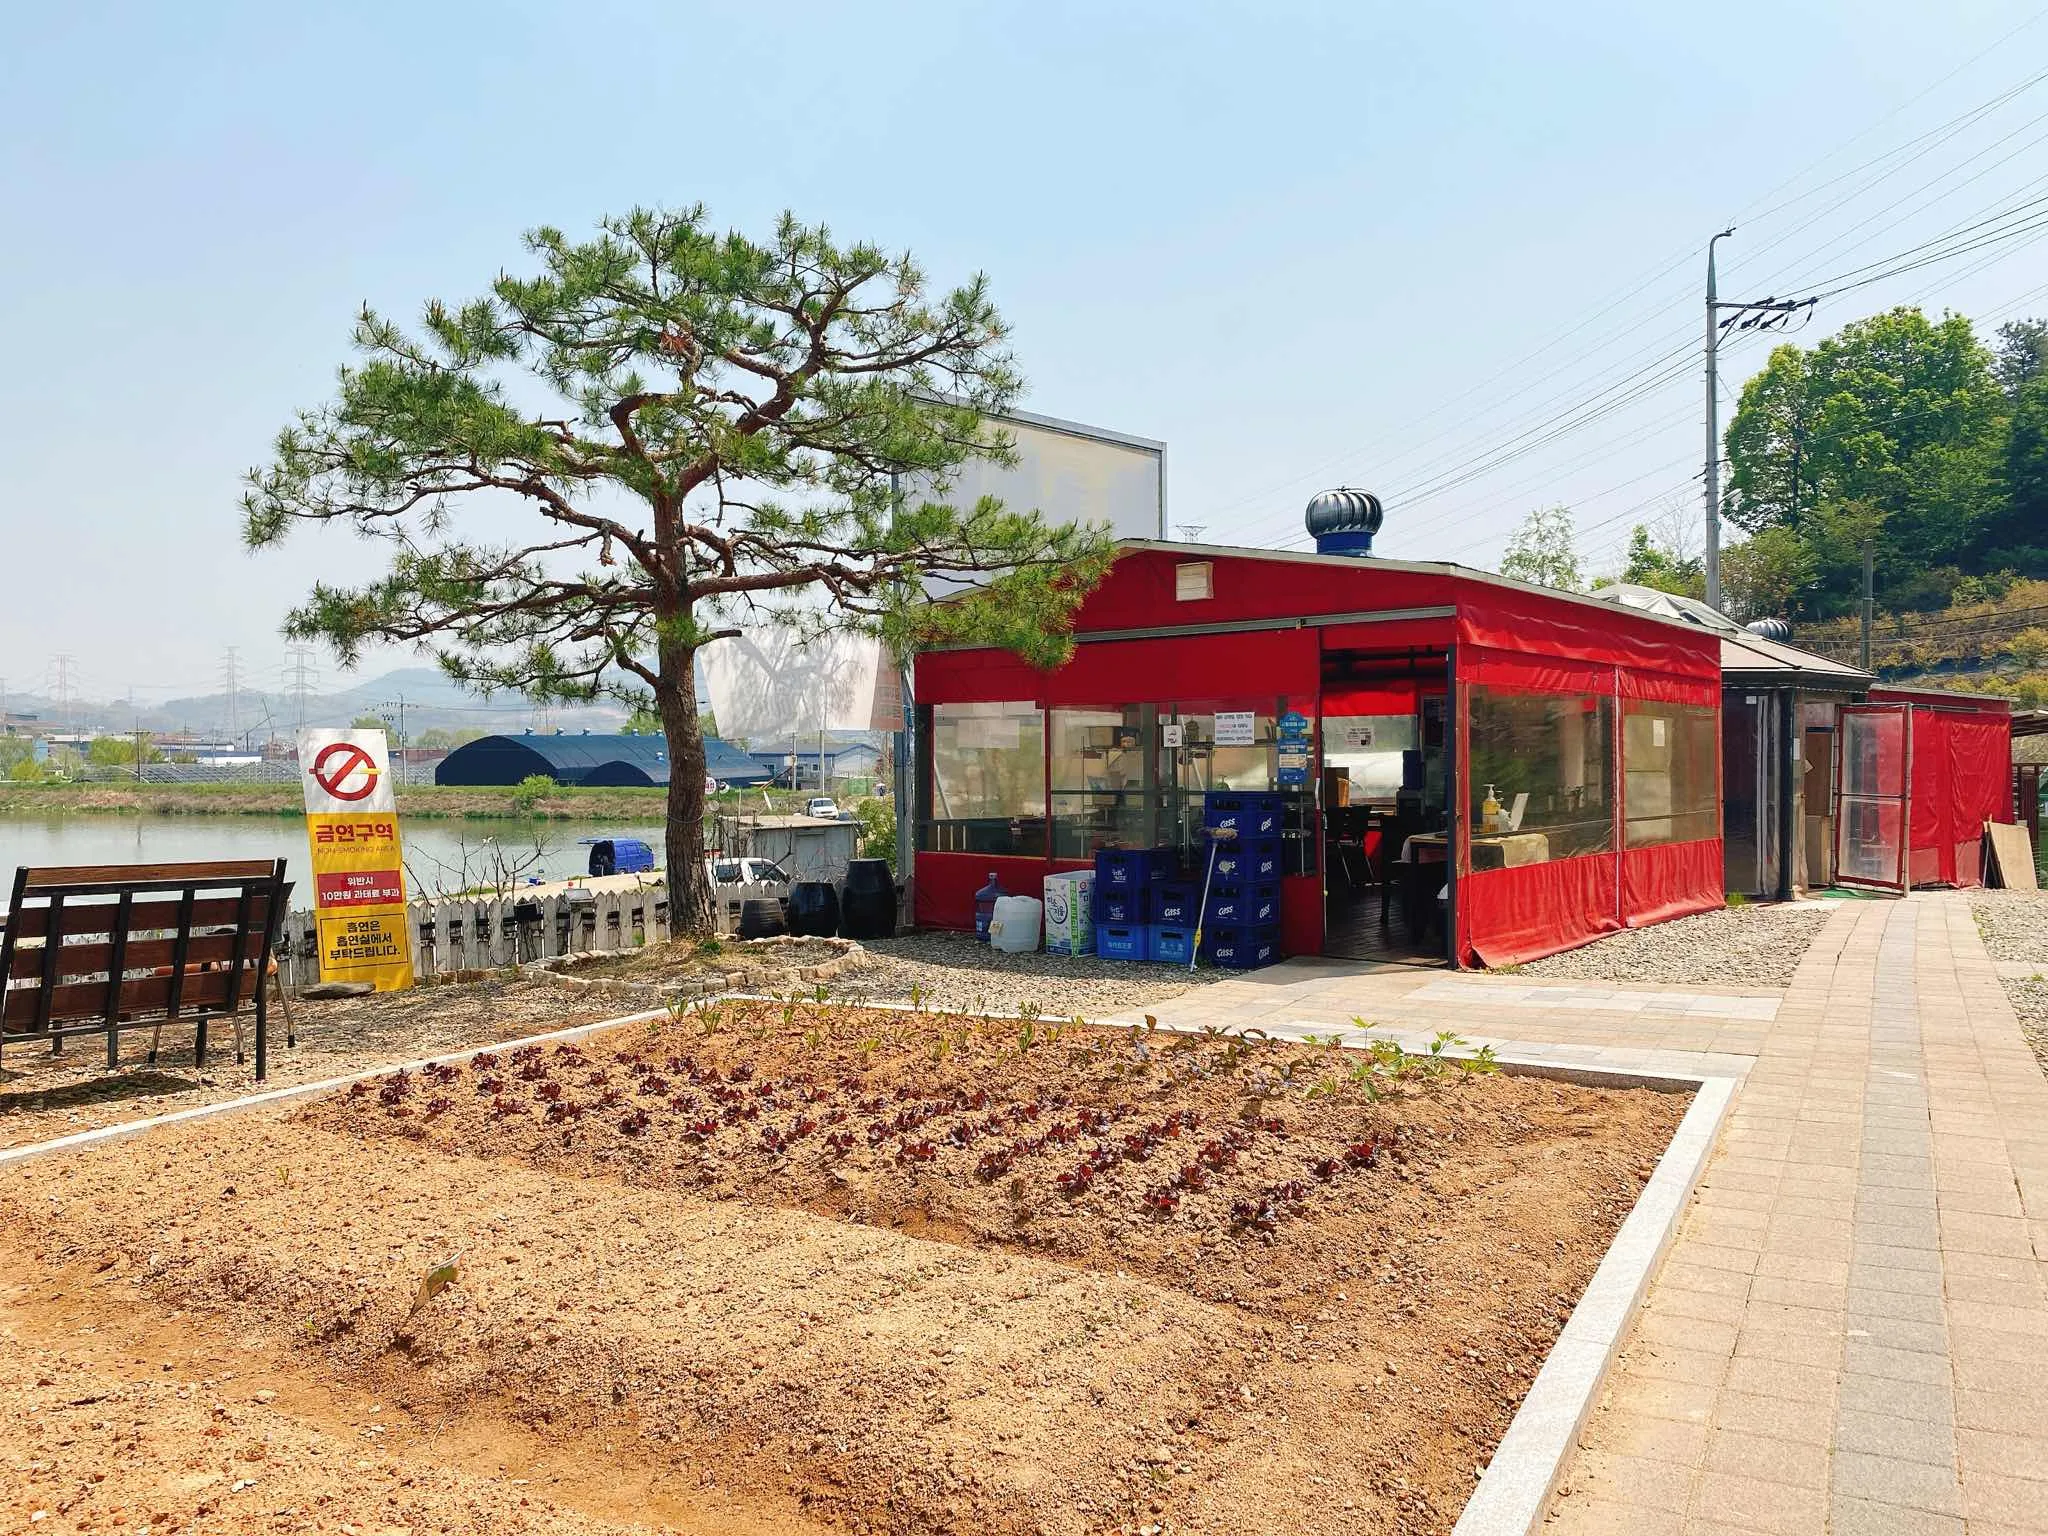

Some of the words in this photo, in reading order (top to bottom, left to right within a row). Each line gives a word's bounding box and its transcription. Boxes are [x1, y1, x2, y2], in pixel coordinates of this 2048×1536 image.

[316, 824, 393, 843] 금연구역
[347, 876, 374, 886] 위반시
[322, 890, 352, 901] 10만원
[354, 889, 380, 899] 과태료
[382, 888, 400, 897] 부과
[1164, 908, 1180, 917] Cass
[1218, 905, 1233, 916] Cass
[347, 921, 380, 933] 흡연은
[337, 932, 392, 947] 흡연실에서
[330, 945, 400, 960] 부탁드립니다.
[1216, 949, 1234, 958] Cass
